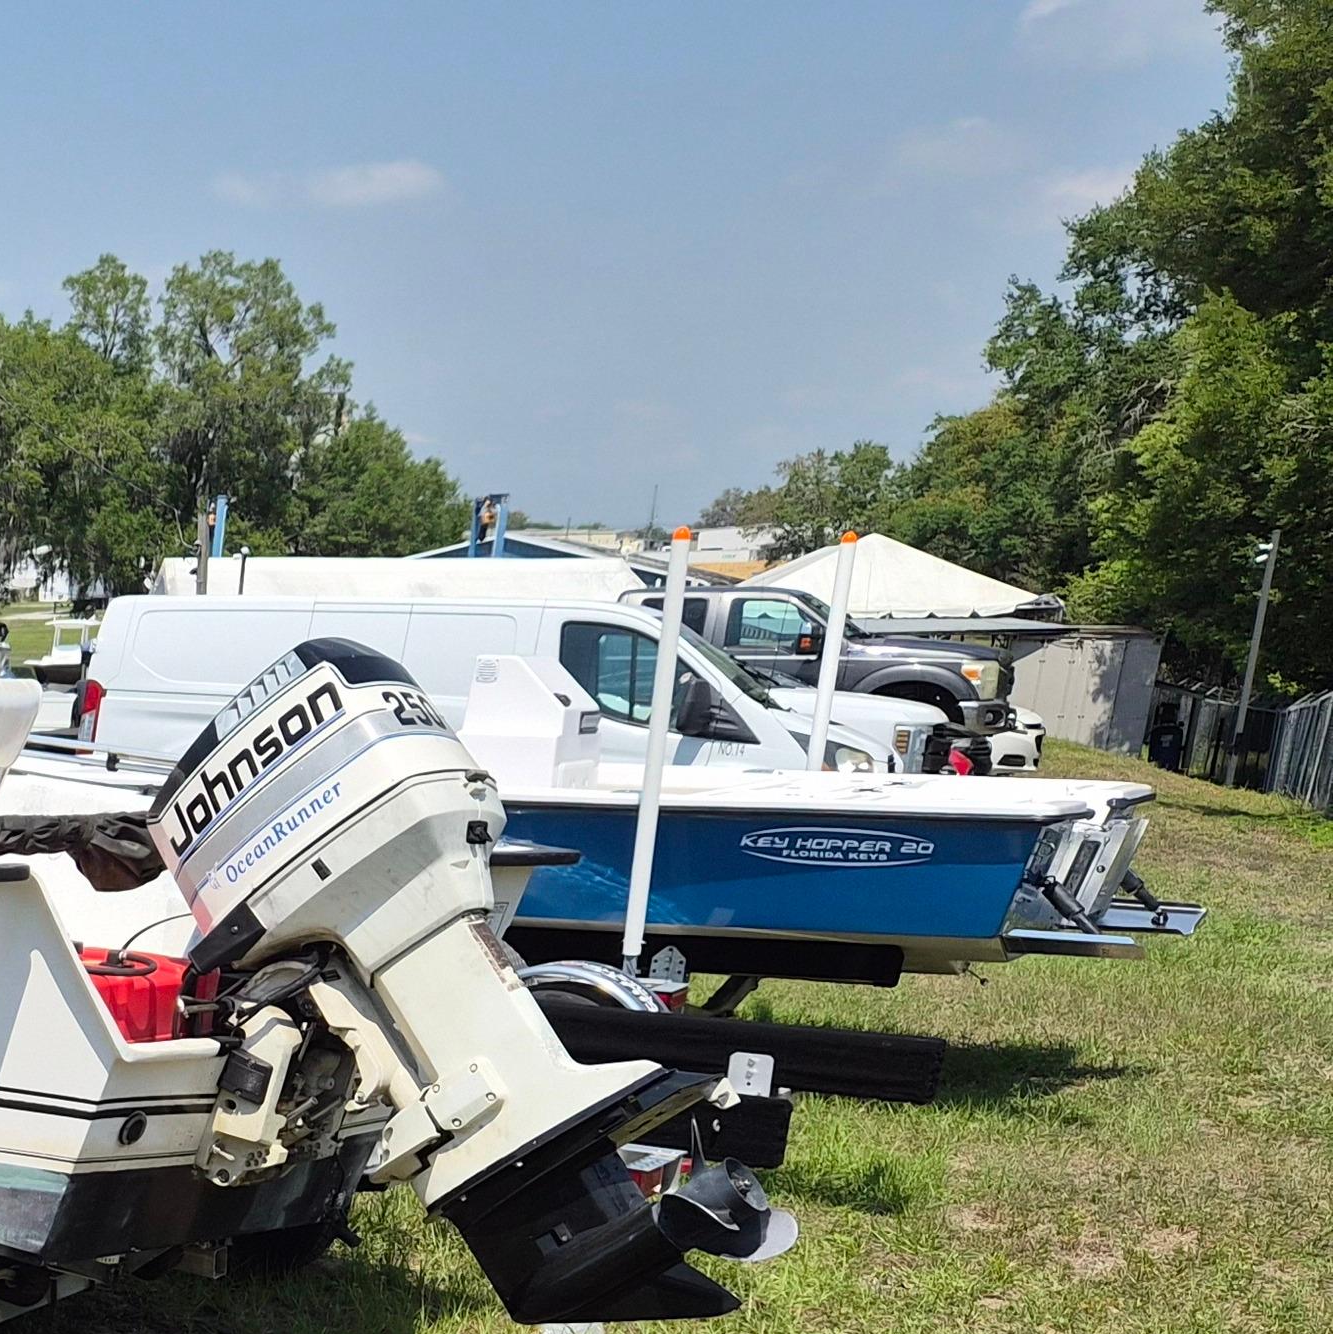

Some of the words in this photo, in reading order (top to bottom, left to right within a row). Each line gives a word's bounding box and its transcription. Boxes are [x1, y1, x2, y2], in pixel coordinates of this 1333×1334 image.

[382, 690, 448, 731] 250
[169, 682, 345, 857] Johnson
[225, 781, 343, 884] OceanRunner
[740, 835, 789, 849] KEY
[796, 838, 892, 853] HOPPER
[900, 841, 935, 854] 20
[782, 850, 844, 860] FLORIDA
[848, 852, 888, 861] KEYS
